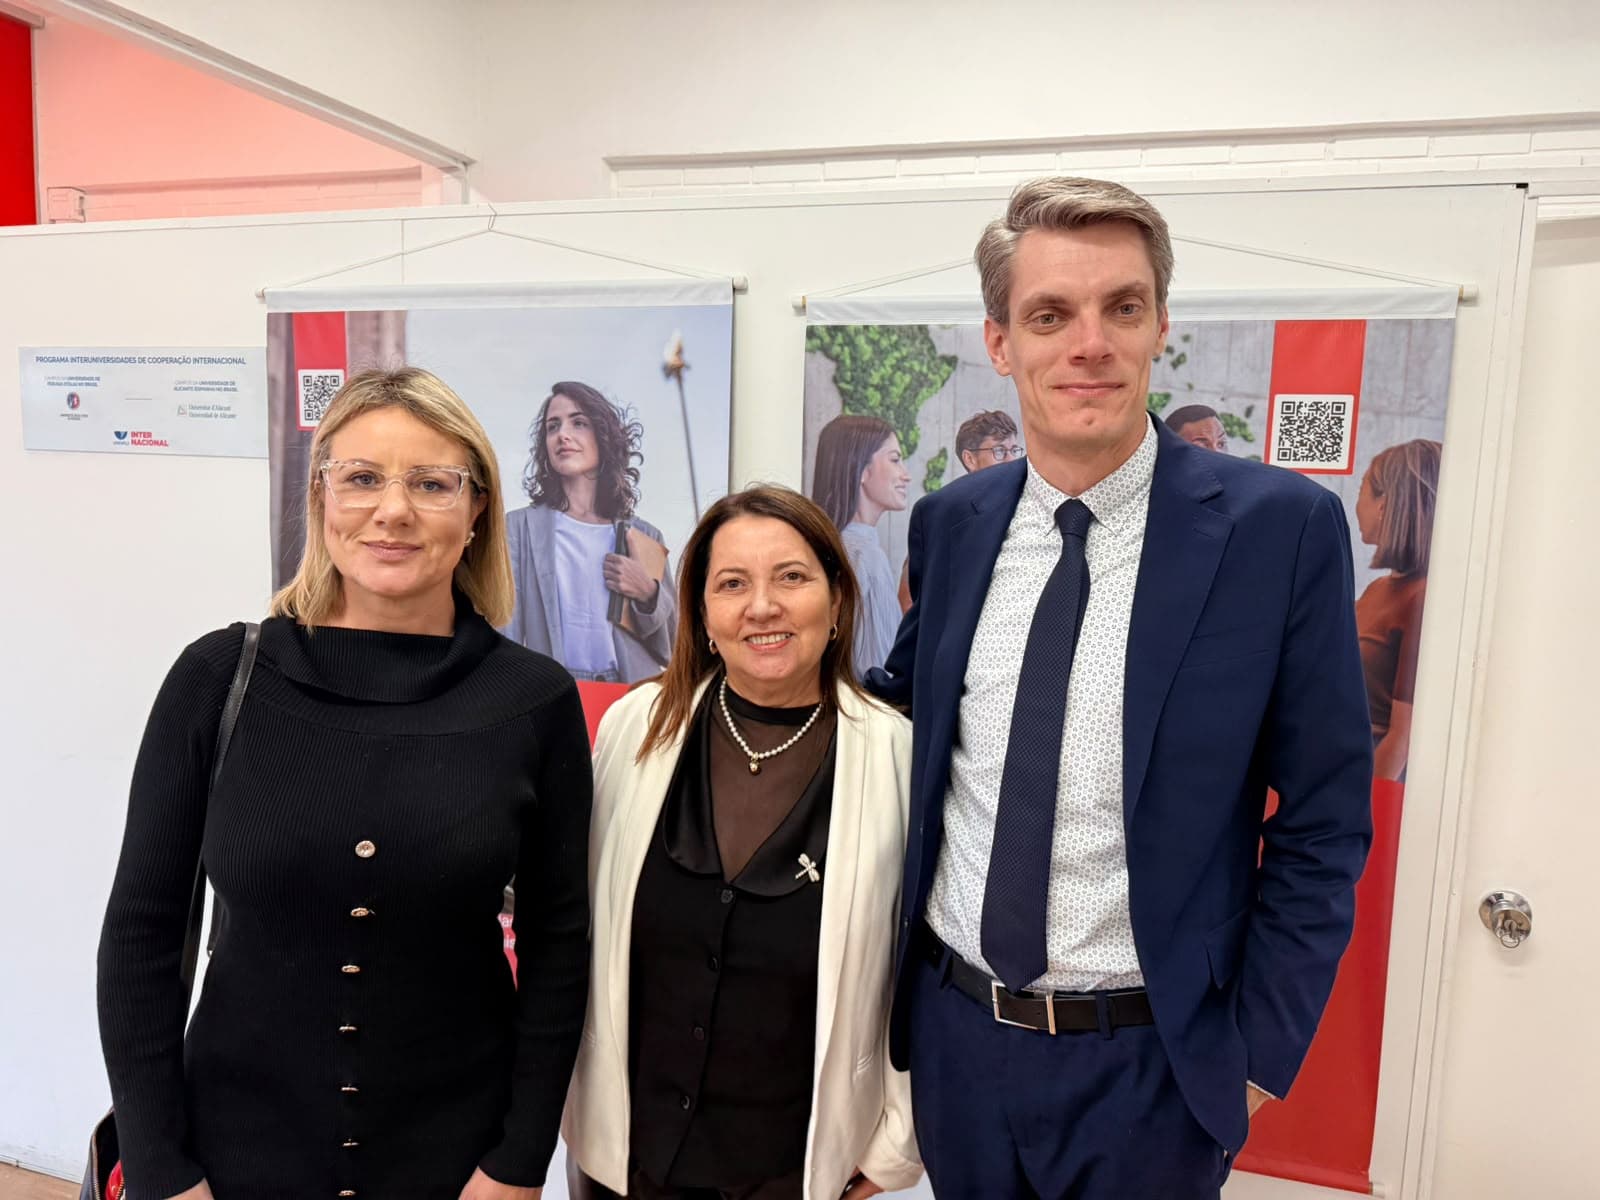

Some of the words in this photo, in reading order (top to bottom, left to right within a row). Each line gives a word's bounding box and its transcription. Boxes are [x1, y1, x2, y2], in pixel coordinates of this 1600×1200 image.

[70, 356, 137, 364] INTERUNIVERSIDADES
[138, 356, 147, 364] DE
[147, 355, 191, 365] COOPERAÇÃO
[192, 356, 246, 365] INTERNACIONAL
[130, 431, 153, 439] INTER
[130, 439, 169, 447] NACIONAL
